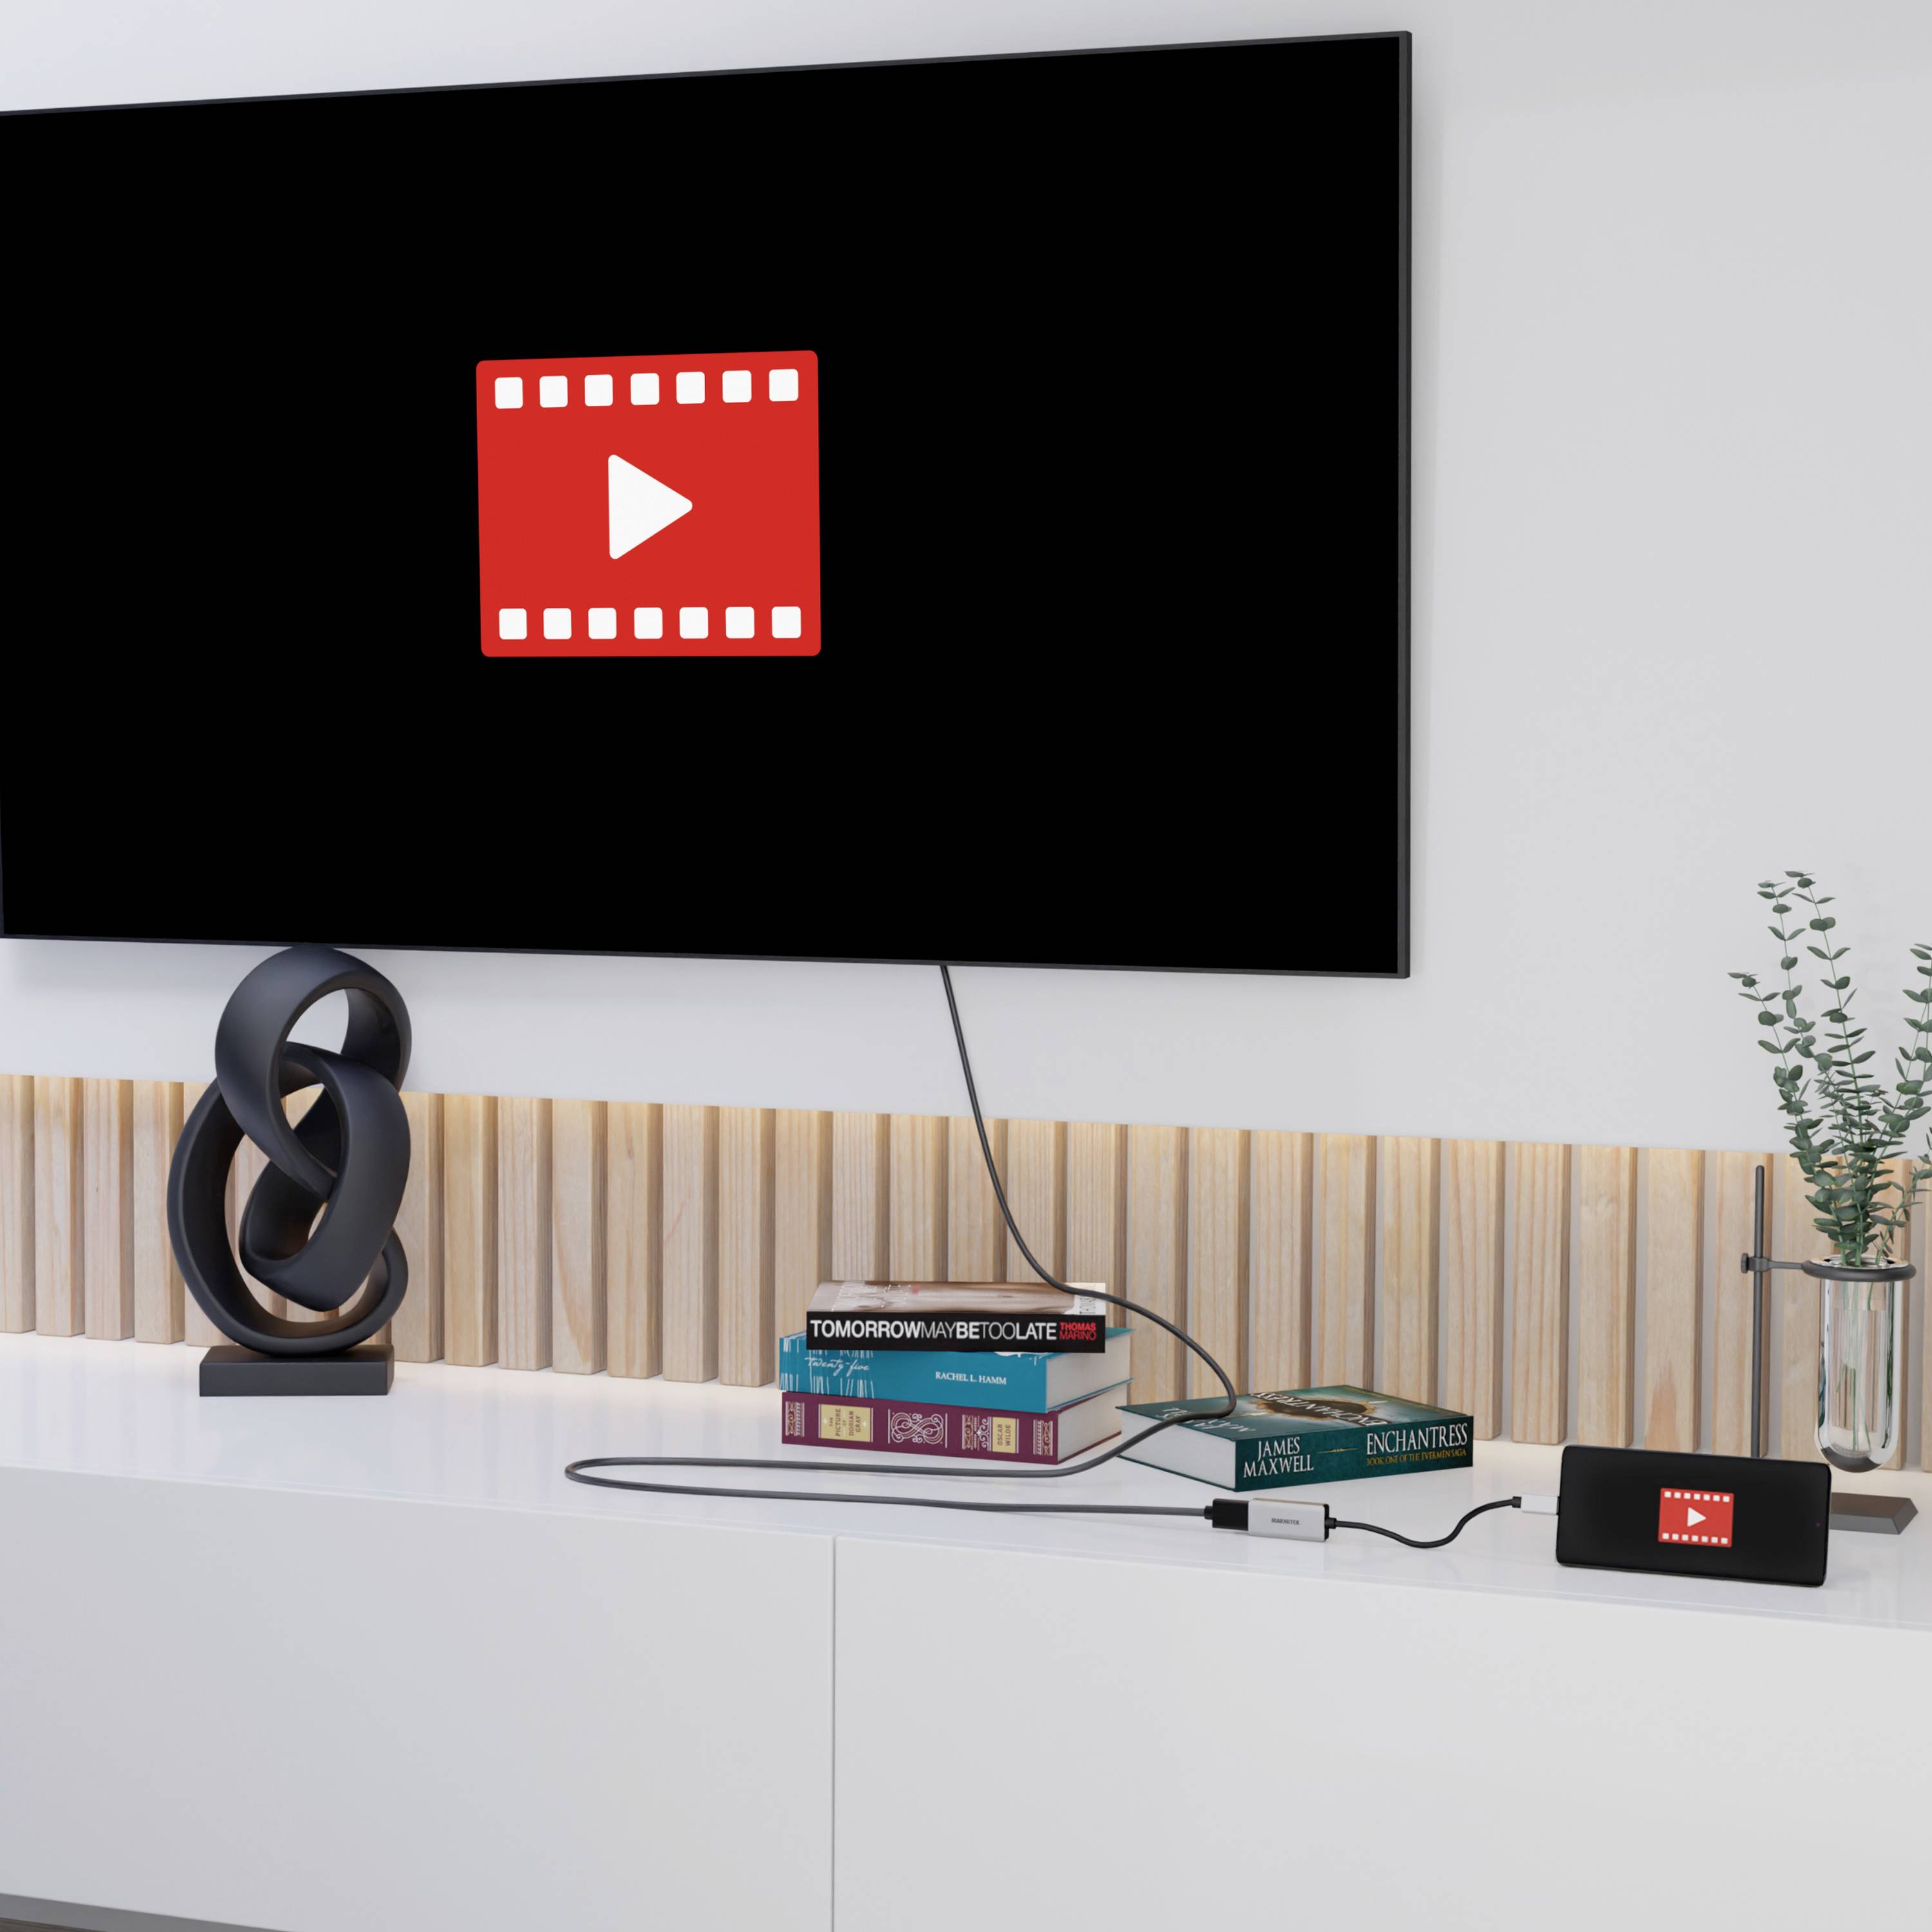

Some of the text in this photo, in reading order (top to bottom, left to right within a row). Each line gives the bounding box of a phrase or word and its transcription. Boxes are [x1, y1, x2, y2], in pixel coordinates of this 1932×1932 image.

[810, 1320, 1057, 1340] TOMORROWMAYBETOOLATE
[1059, 1321, 1096, 1331] THOMAS
[1059, 1331, 1097, 1340] MARINO
[935, 1371, 1007, 1385] RACHEL L. HAMM
[1367, 1423, 1468, 1455] ENCHANTRESS
[1257, 1437, 1300, 1462] JAMES
[1243, 1454, 1314, 1478] MAXWELL
[1367, 1457, 1383, 1466] BOOK
